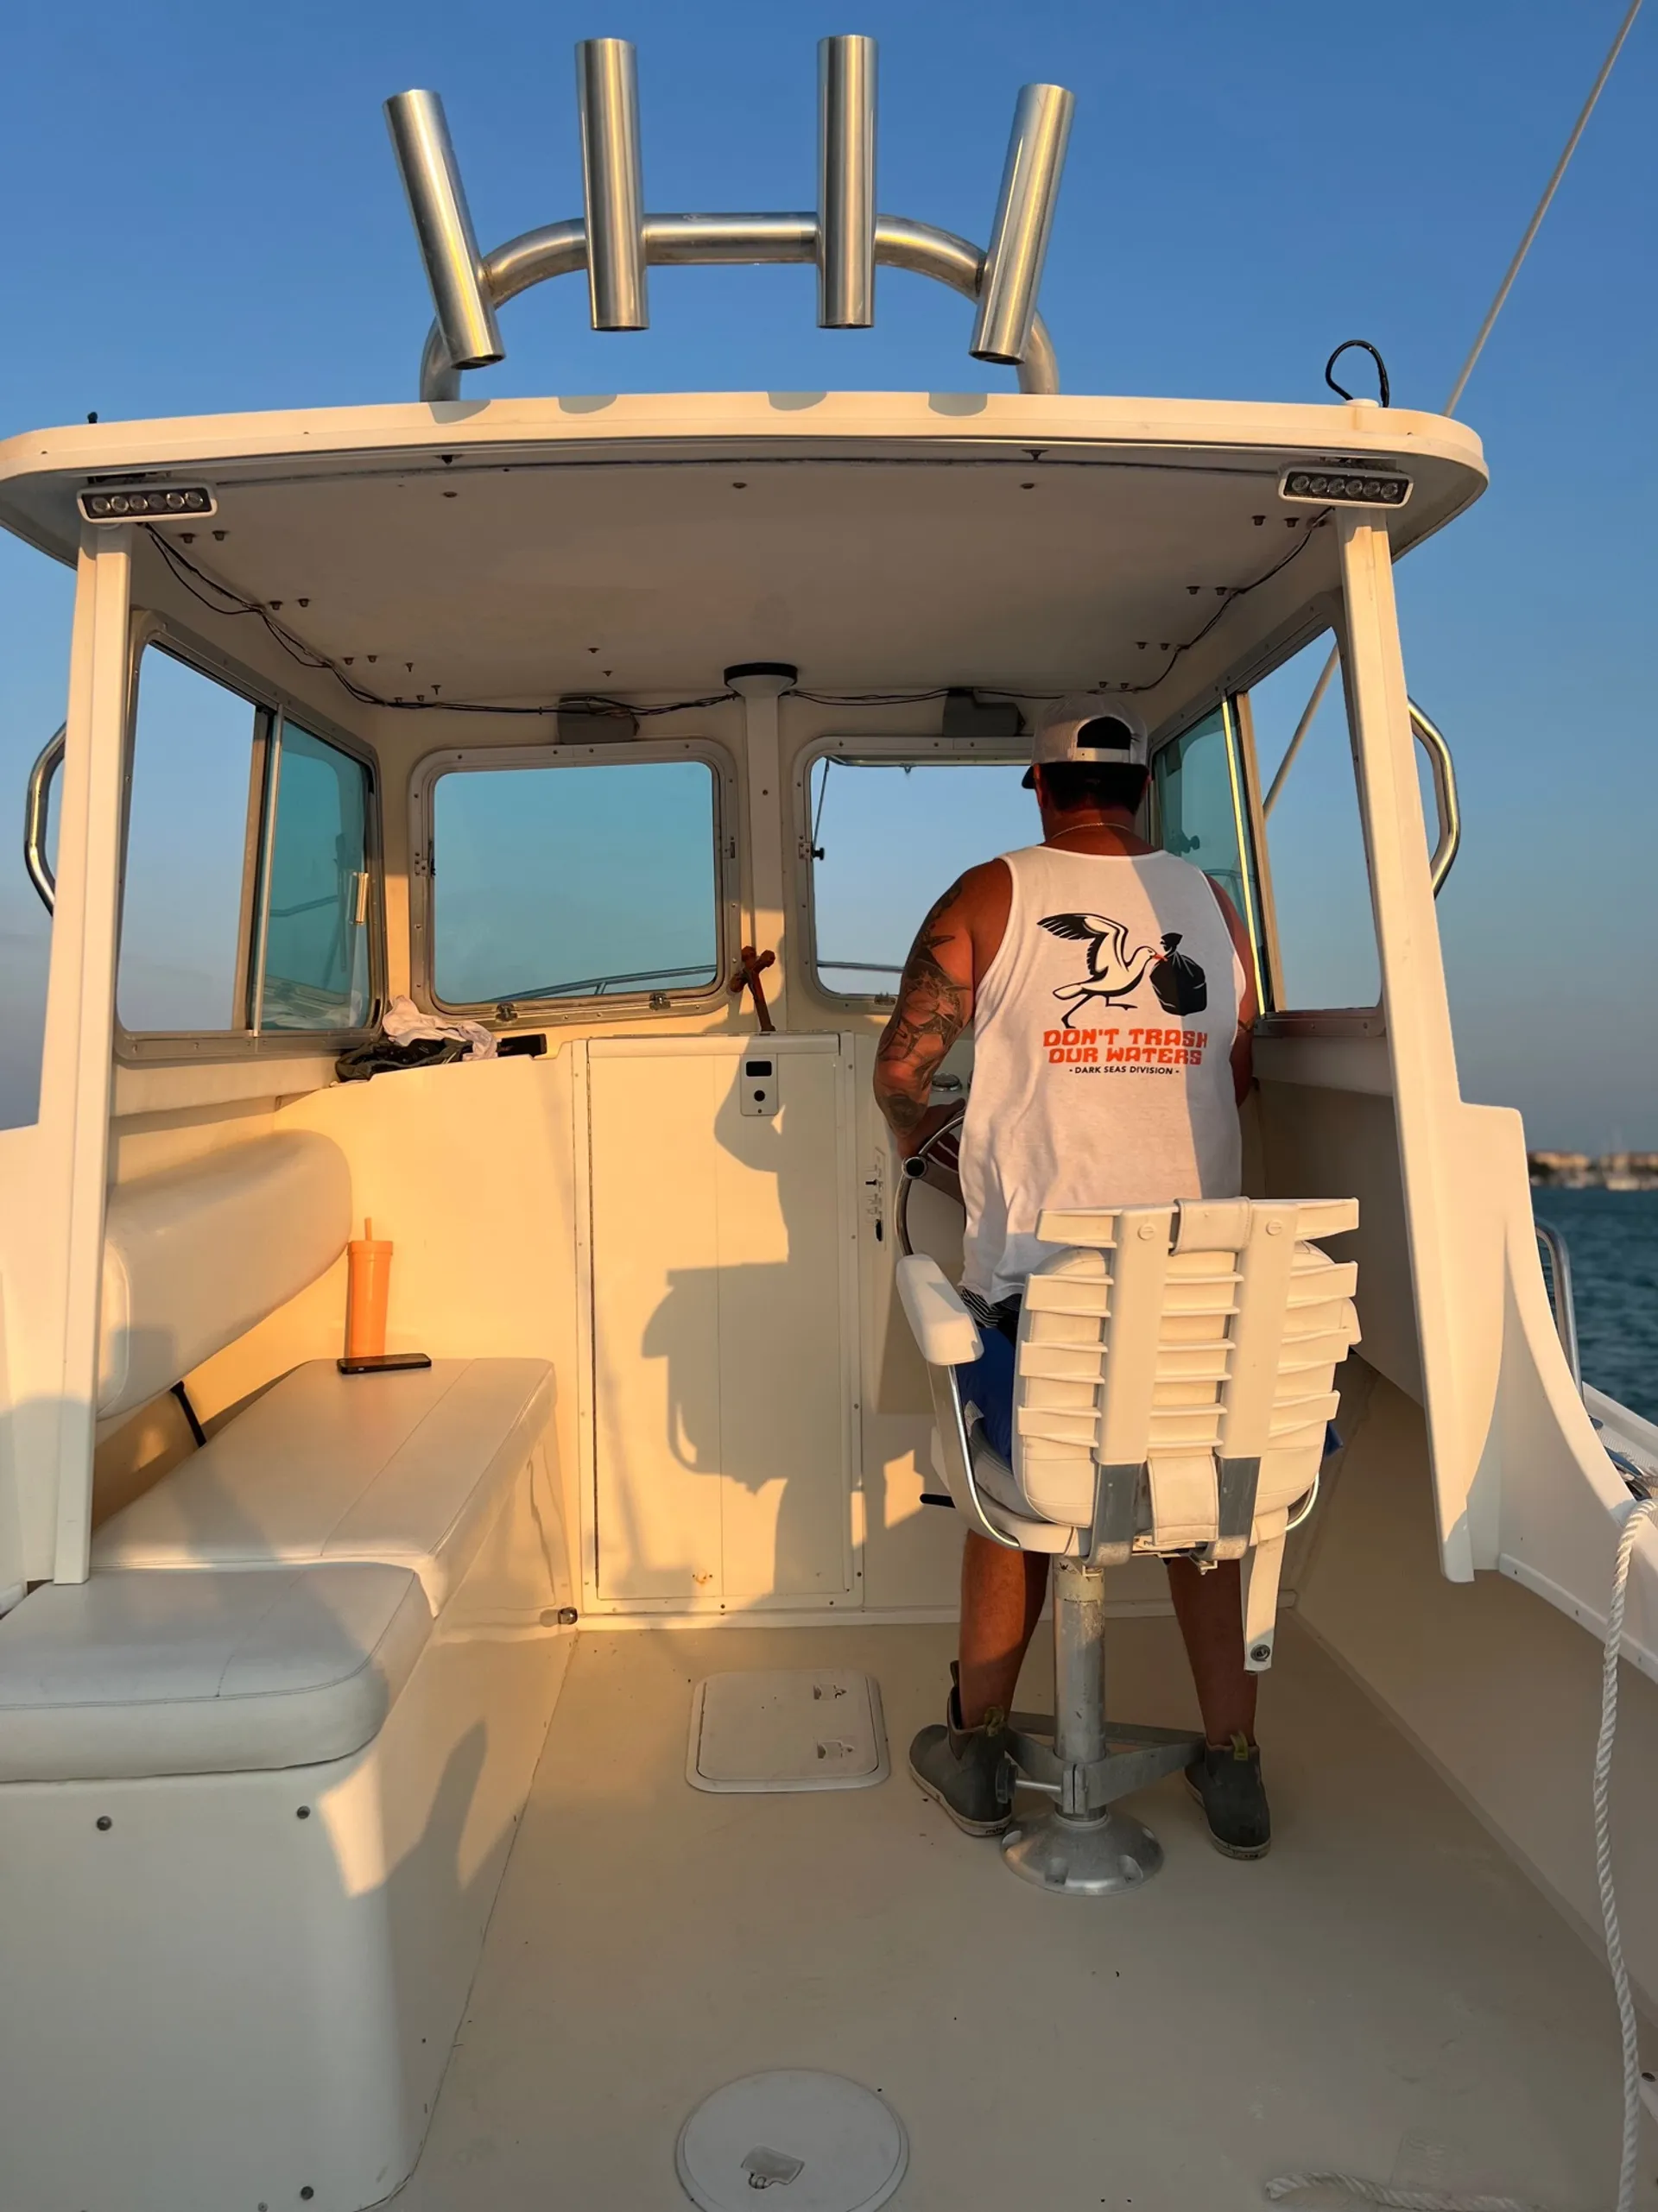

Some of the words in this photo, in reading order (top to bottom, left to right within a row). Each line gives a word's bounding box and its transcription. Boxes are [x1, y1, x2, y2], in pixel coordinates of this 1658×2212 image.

[1043, 1028, 1119, 1046] DON'T
[1129, 1028, 1207, 1048] TRASH
[1048, 1047, 1098, 1063] OUR
[1105, 1046, 1202, 1065] WATERS
[1130, 1065, 1173, 1074] DIVISION
